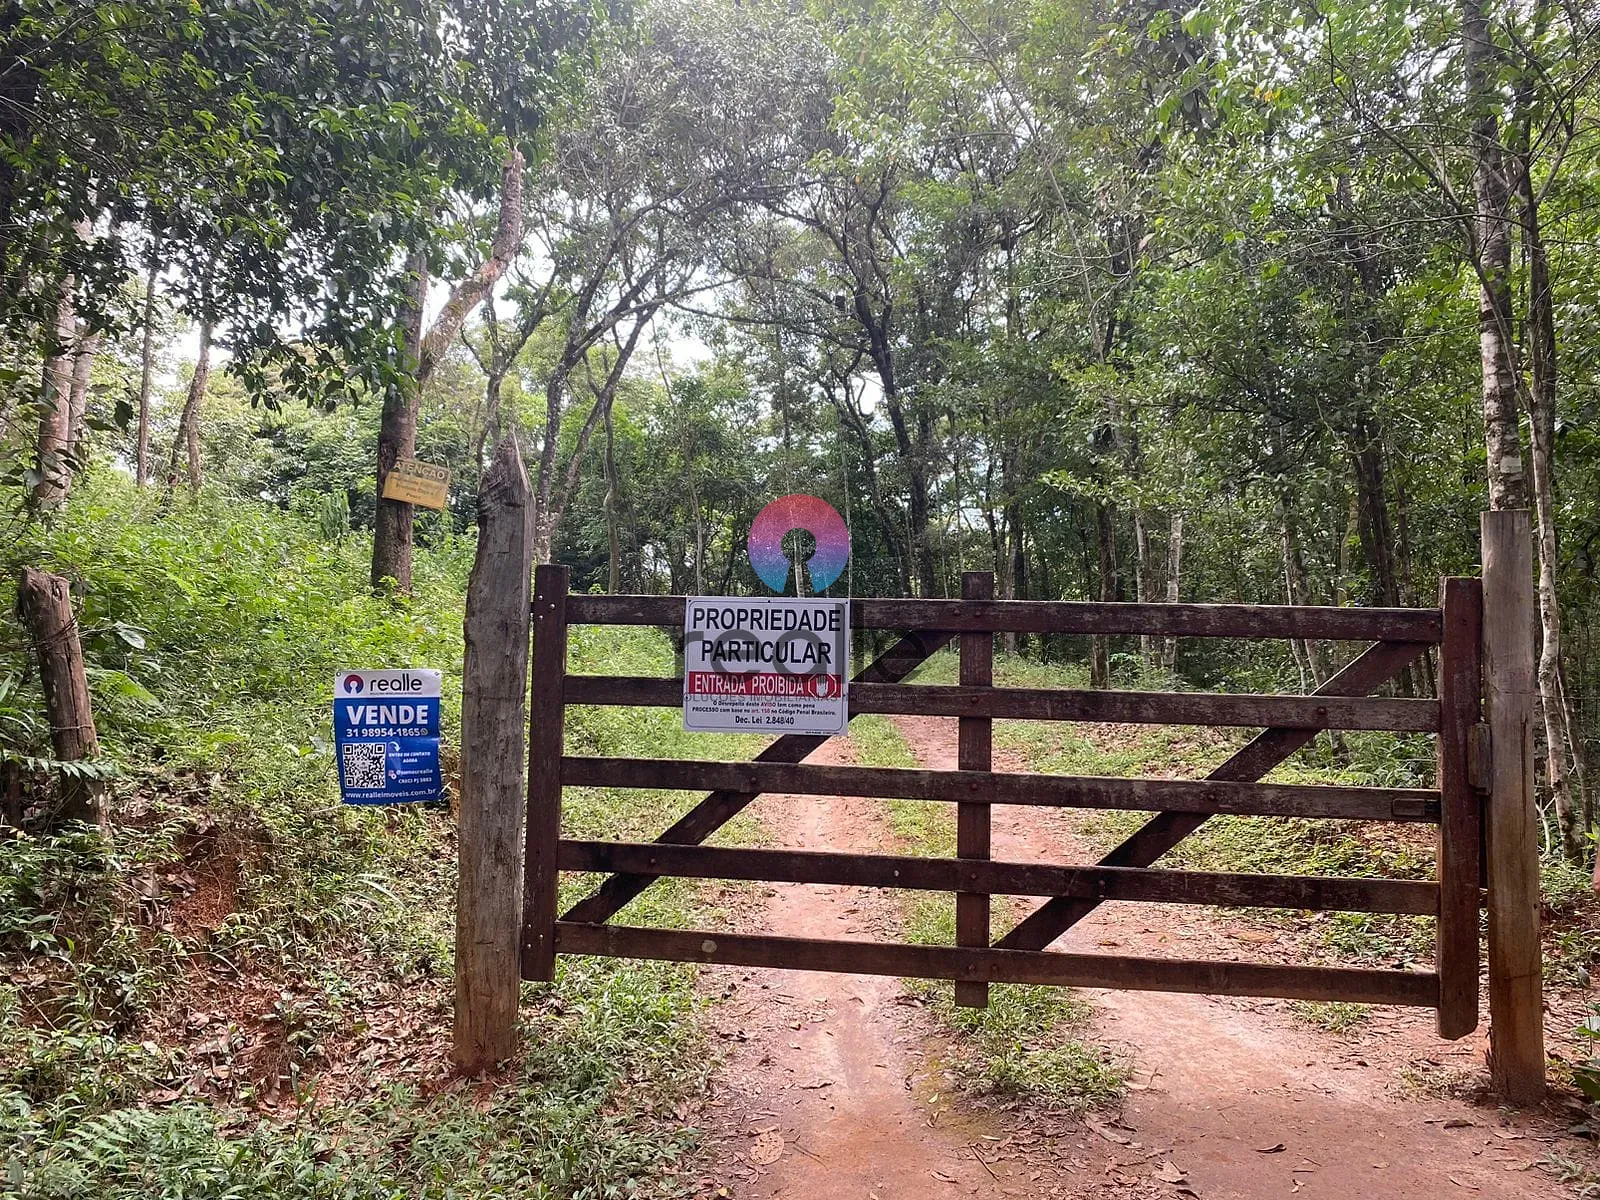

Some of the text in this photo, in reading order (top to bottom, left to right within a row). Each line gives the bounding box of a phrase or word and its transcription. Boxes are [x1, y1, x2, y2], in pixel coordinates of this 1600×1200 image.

[693, 608, 841, 632] PROPRIEDADE
[701, 640, 832, 664] PARTICULAR
[370, 673, 422, 692] realle
[695, 674, 804, 694] ENTRADA PROIBIDA
[346, 705, 428, 725] VENDE
[736, 716, 750, 724] Dec.
[766, 716, 794, 724] 2.848/40
[346, 728, 420, 737] 31 98954-1865
